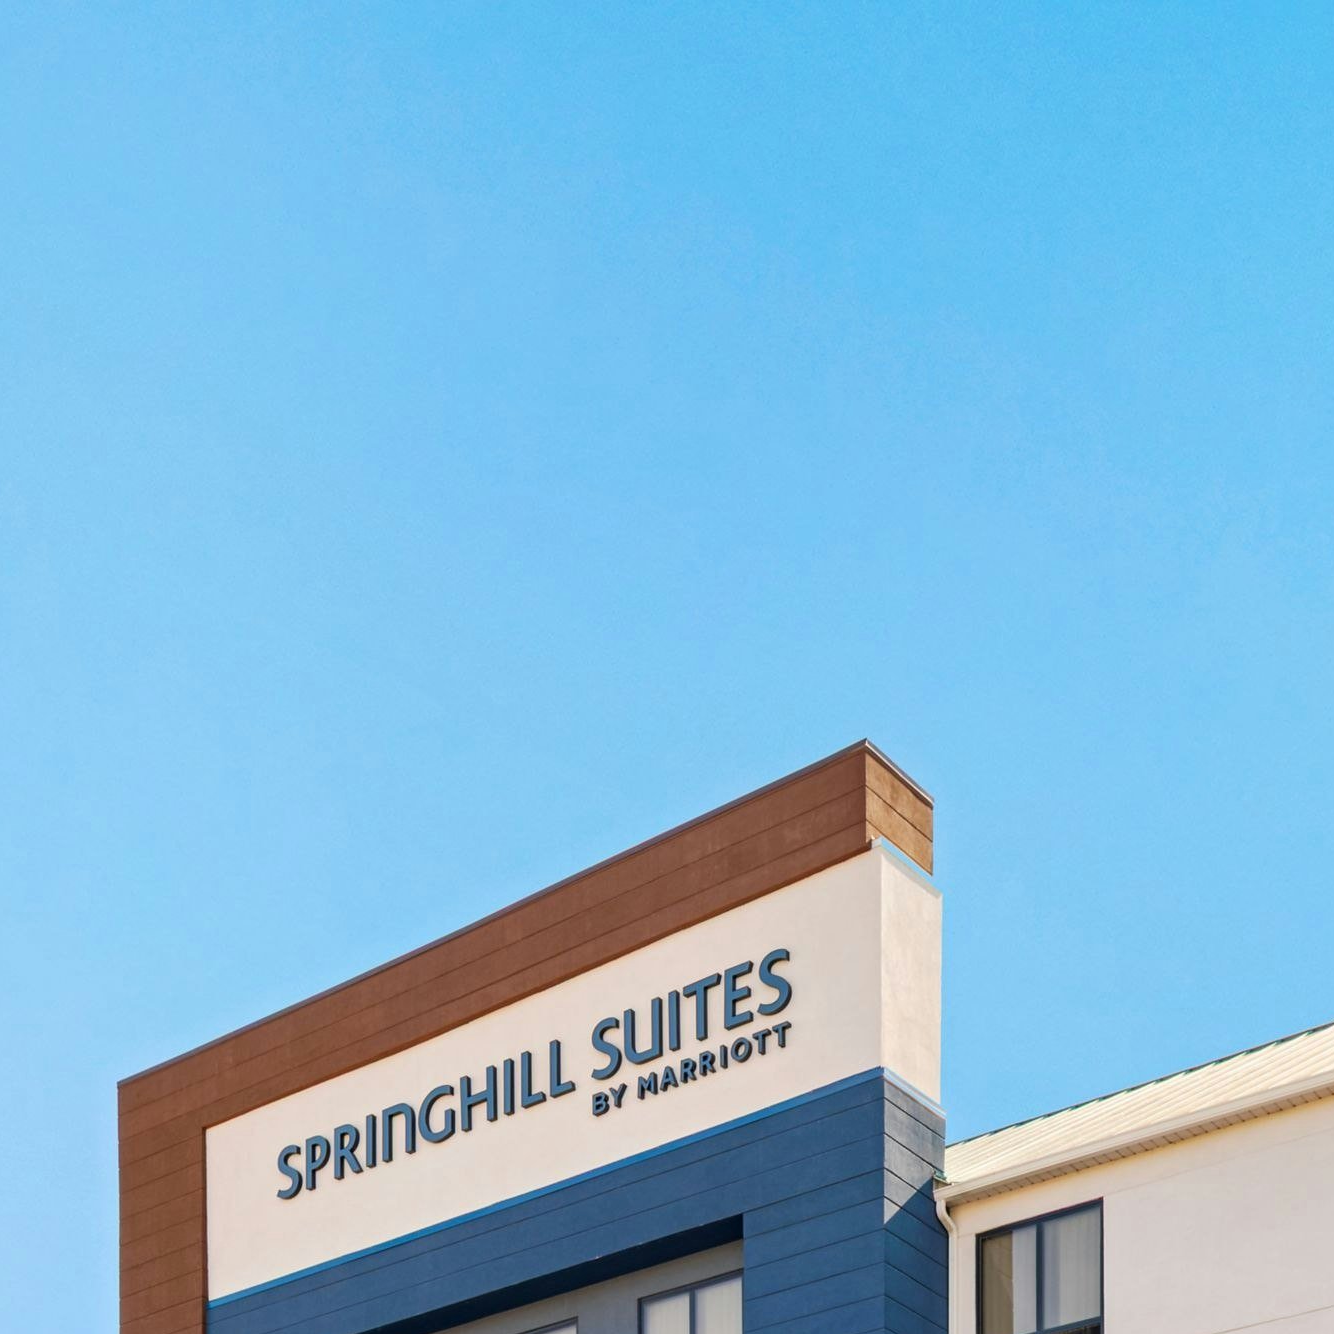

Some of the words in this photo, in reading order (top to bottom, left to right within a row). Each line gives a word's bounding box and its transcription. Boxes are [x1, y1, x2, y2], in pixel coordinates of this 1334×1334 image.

[276, 1039, 577, 1201] SPRINGHILL
[590, 948, 793, 1082] SUITES
[591, 1082, 628, 1118] BY
[637, 1020, 793, 1101] MARRIOTT
